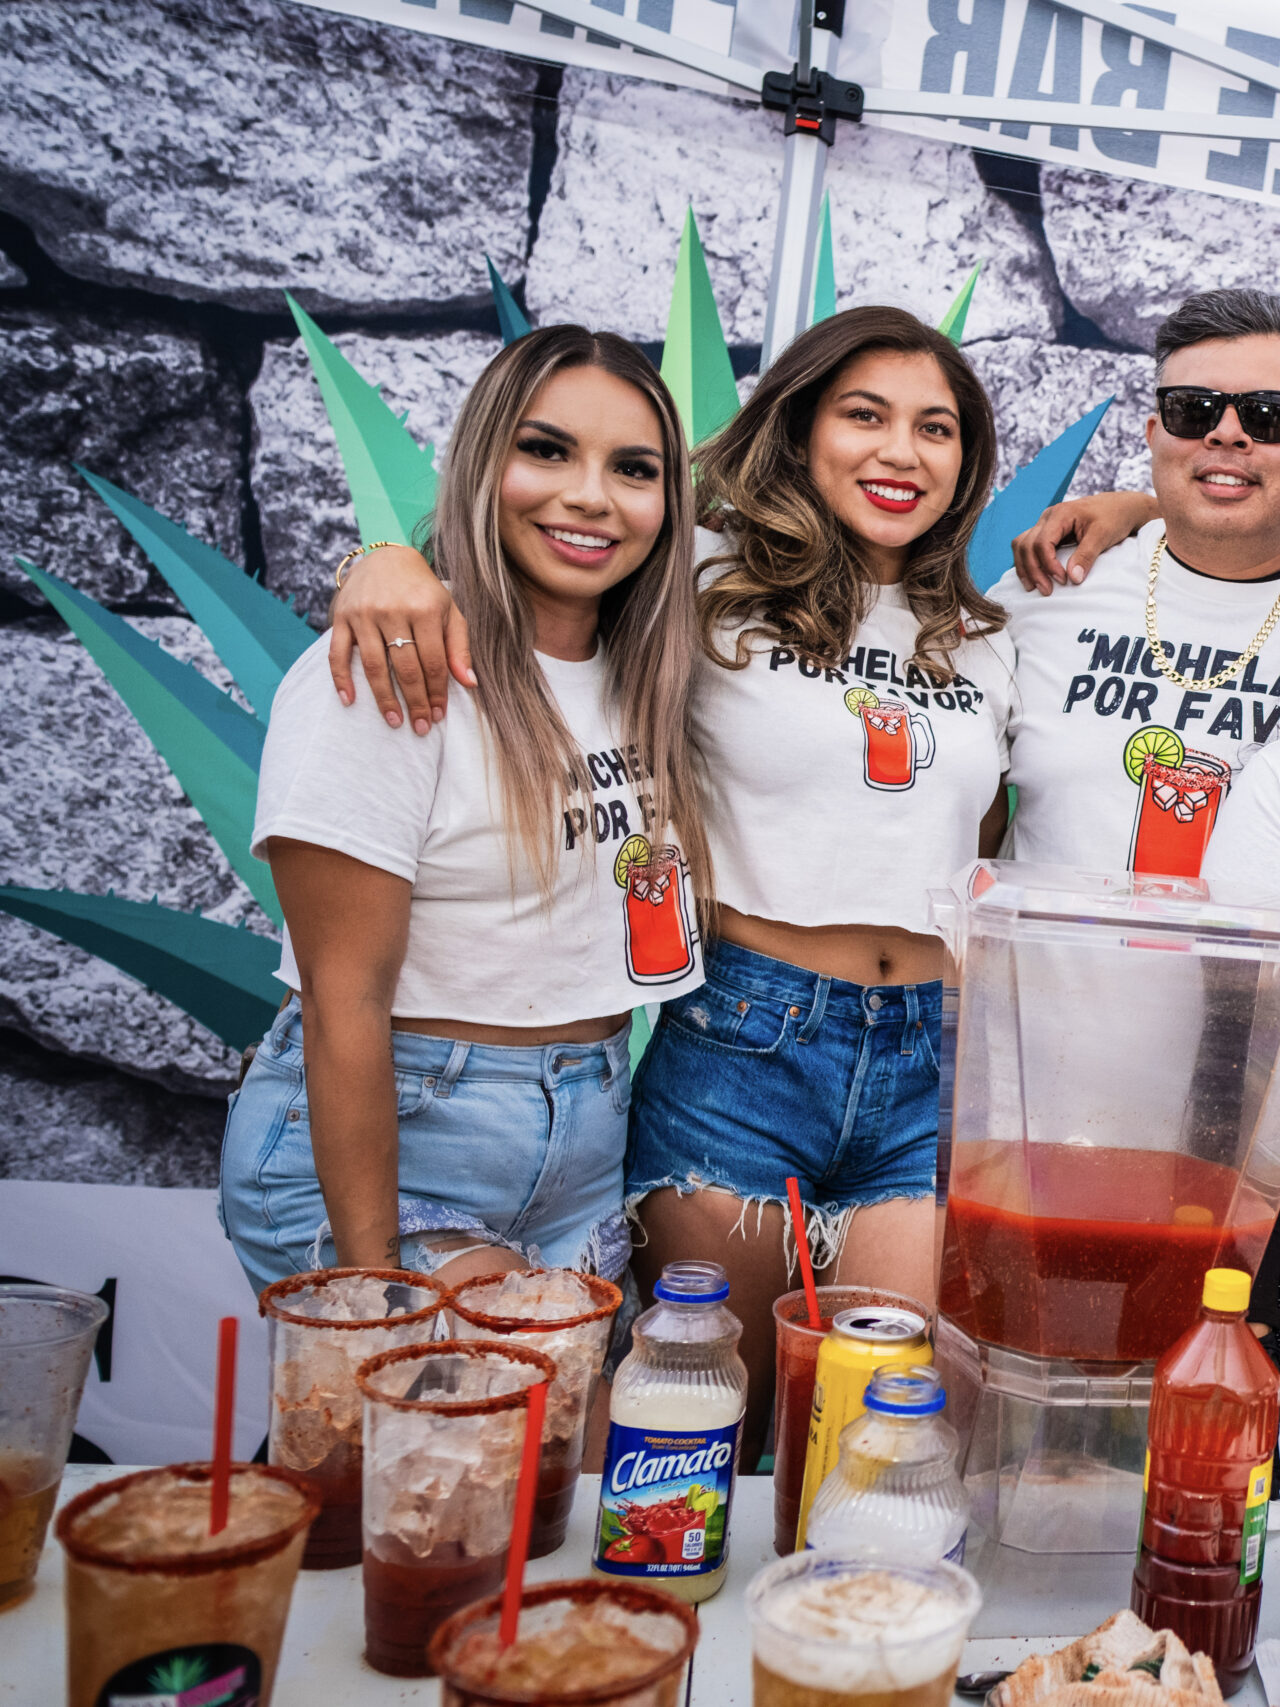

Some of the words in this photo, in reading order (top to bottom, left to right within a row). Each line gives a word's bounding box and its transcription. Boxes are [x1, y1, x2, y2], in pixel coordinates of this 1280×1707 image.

[769, 646, 848, 685] POR
[1063, 674, 1159, 724] POR
[563, 799, 631, 851] POR
[644, 1436, 673, 1445] TOMATO
[673, 1437, 707, 1445] COCKTAIL
[611, 1440, 732, 1495] Clamato
[688, 1532, 701, 1542] 50
